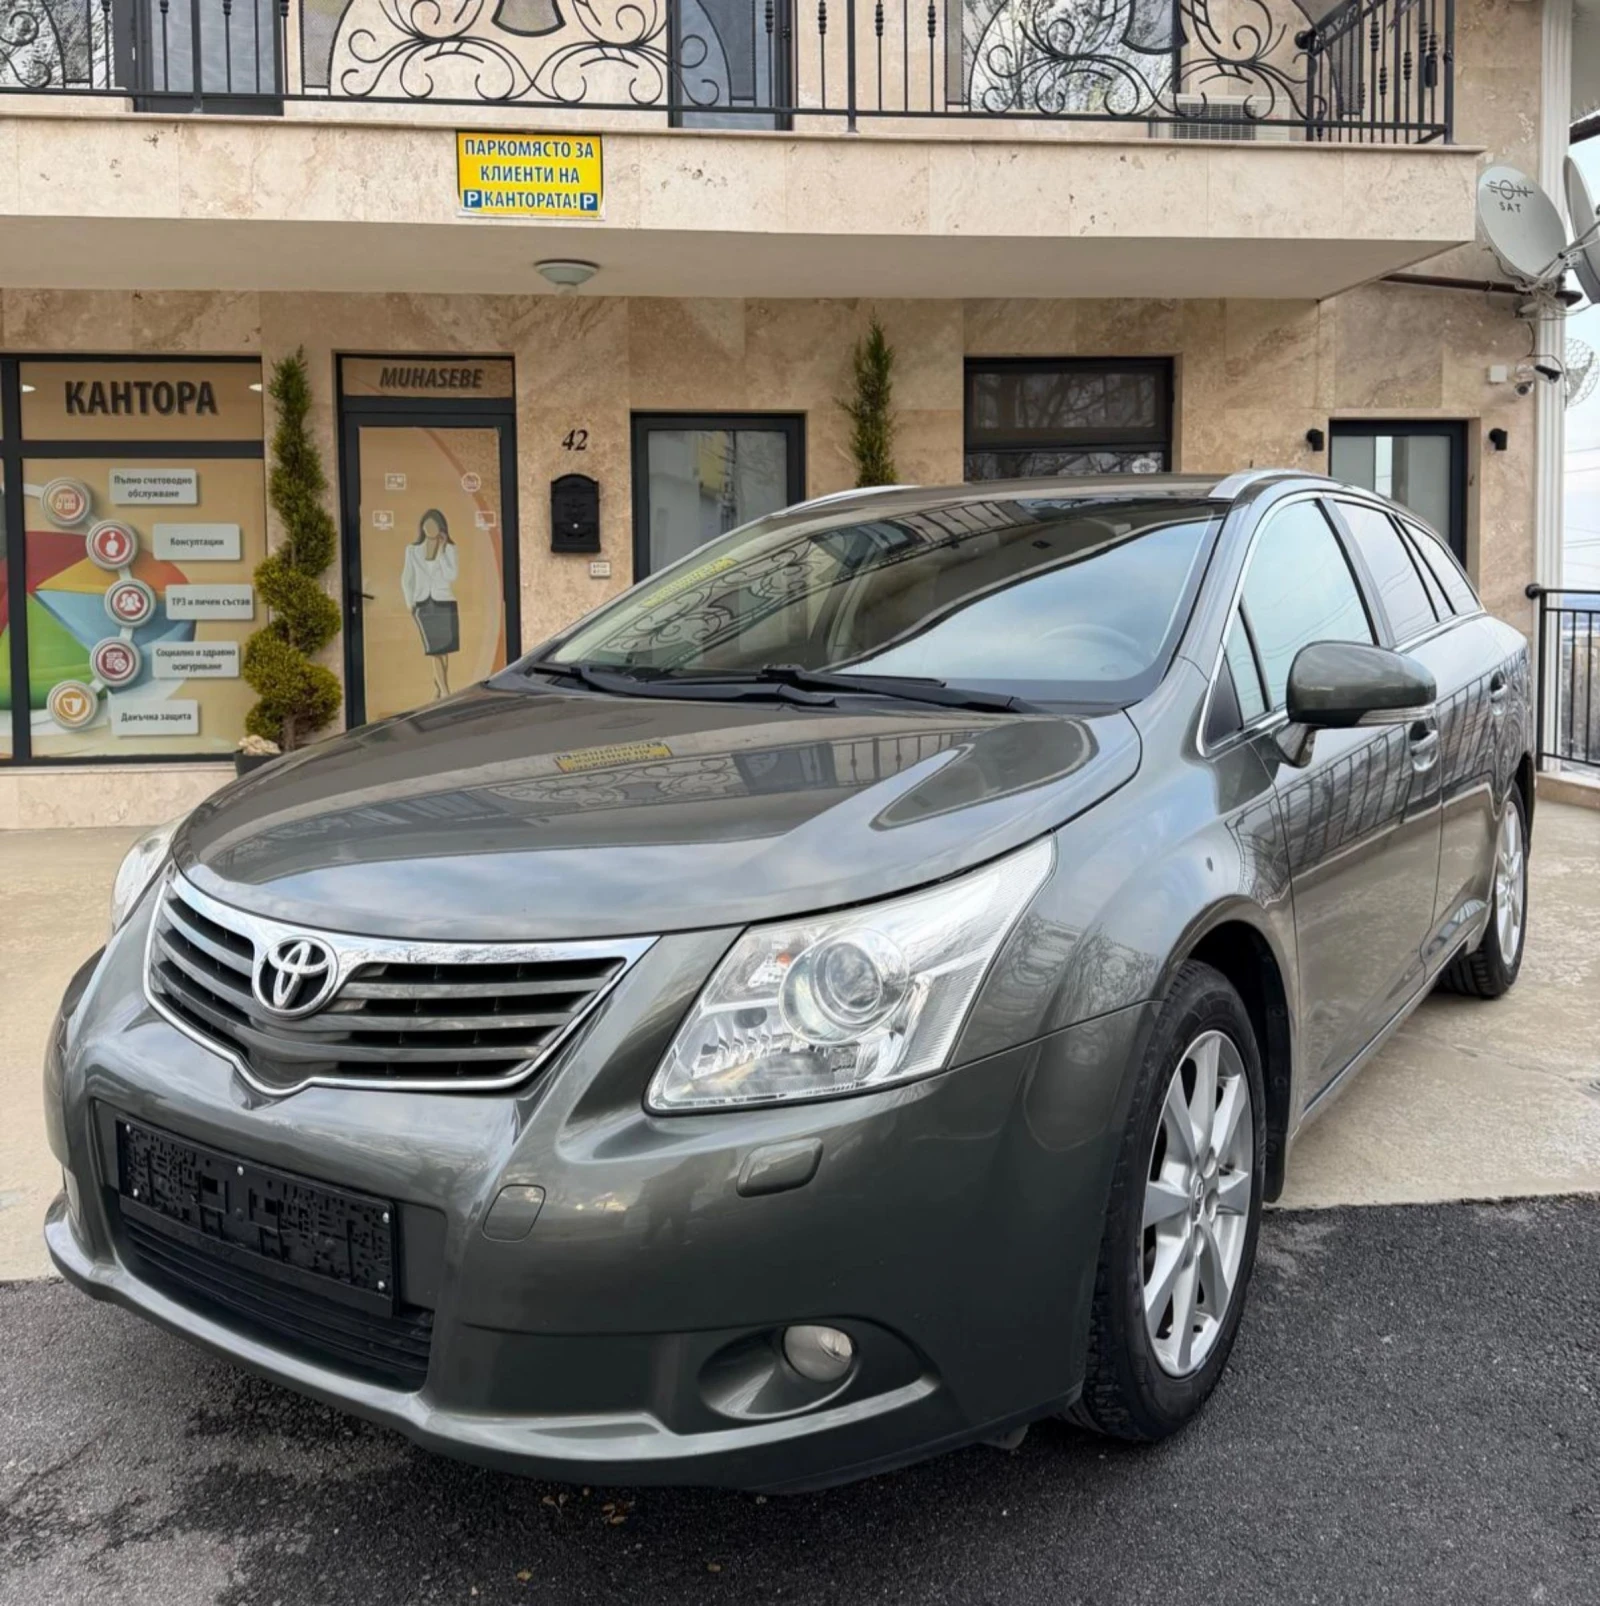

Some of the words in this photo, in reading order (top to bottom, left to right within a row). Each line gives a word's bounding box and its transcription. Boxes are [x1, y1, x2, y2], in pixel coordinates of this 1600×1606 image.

[465, 139, 572, 158] ПАРКОМЯСТО
[575, 142, 594, 158] ЗА
[480, 165, 554, 183] КЛИЕНТИ
[559, 168, 580, 184] НА
[484, 191, 577, 209] КАНТОРАТА!
[1499, 201, 1521, 213] SAT
[379, 367, 484, 389] MUHASEBE
[64, 380, 219, 416] КАНТОРА
[561, 429, 589, 451] 42
[114, 475, 142, 485] Пълно
[143, 476, 193, 486] счетоводно
[127, 488, 180, 500] обслужване
[222, 598, 251, 606] състав
[156, 647, 194, 658] Социално
[195, 649, 201, 657] и
[202, 648, 236, 659] здравно
[121, 712, 159, 723] Данъчна
[160, 713, 192, 722] защита
